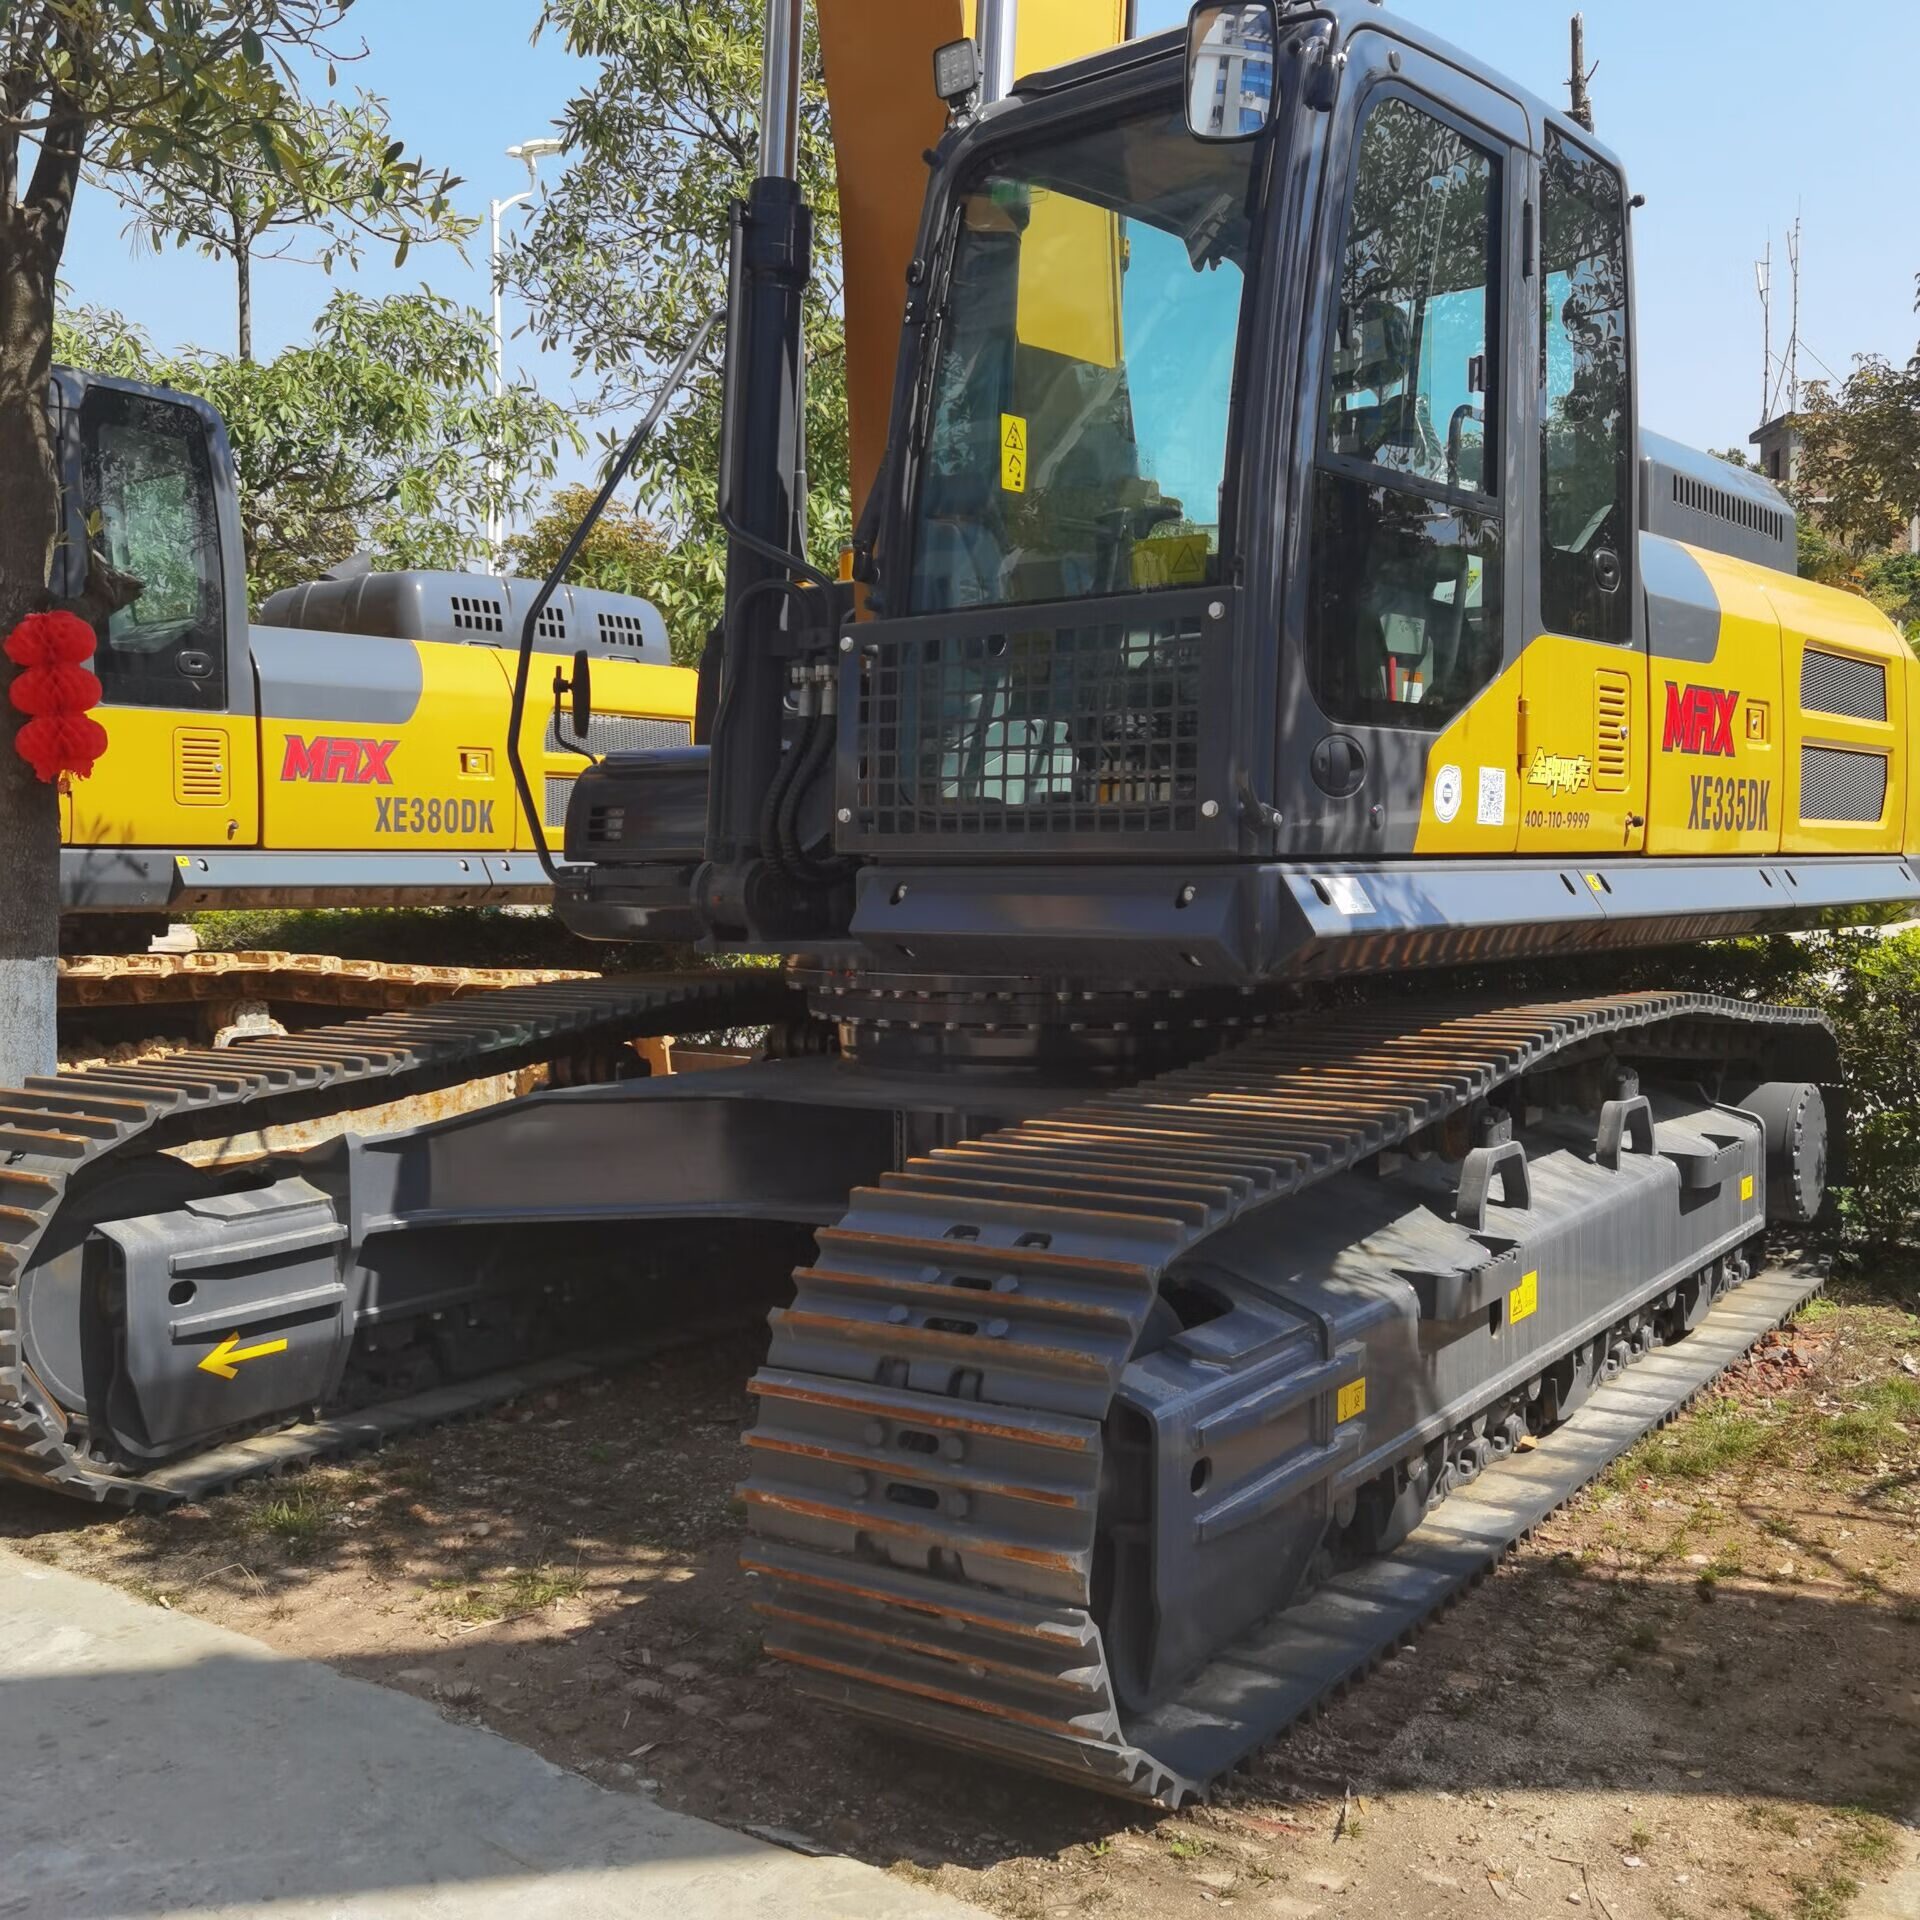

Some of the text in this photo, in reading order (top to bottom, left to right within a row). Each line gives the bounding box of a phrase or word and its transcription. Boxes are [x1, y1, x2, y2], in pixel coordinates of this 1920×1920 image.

[1662, 680, 1740, 757] MAX
[280, 734, 401, 784] MAX
[1527, 746, 1592, 798] 金牌服务
[374, 797, 495, 834] XE380DK
[1525, 810, 1590, 829] 400-110-9999
[1688, 775, 1770, 831] XE335DK
